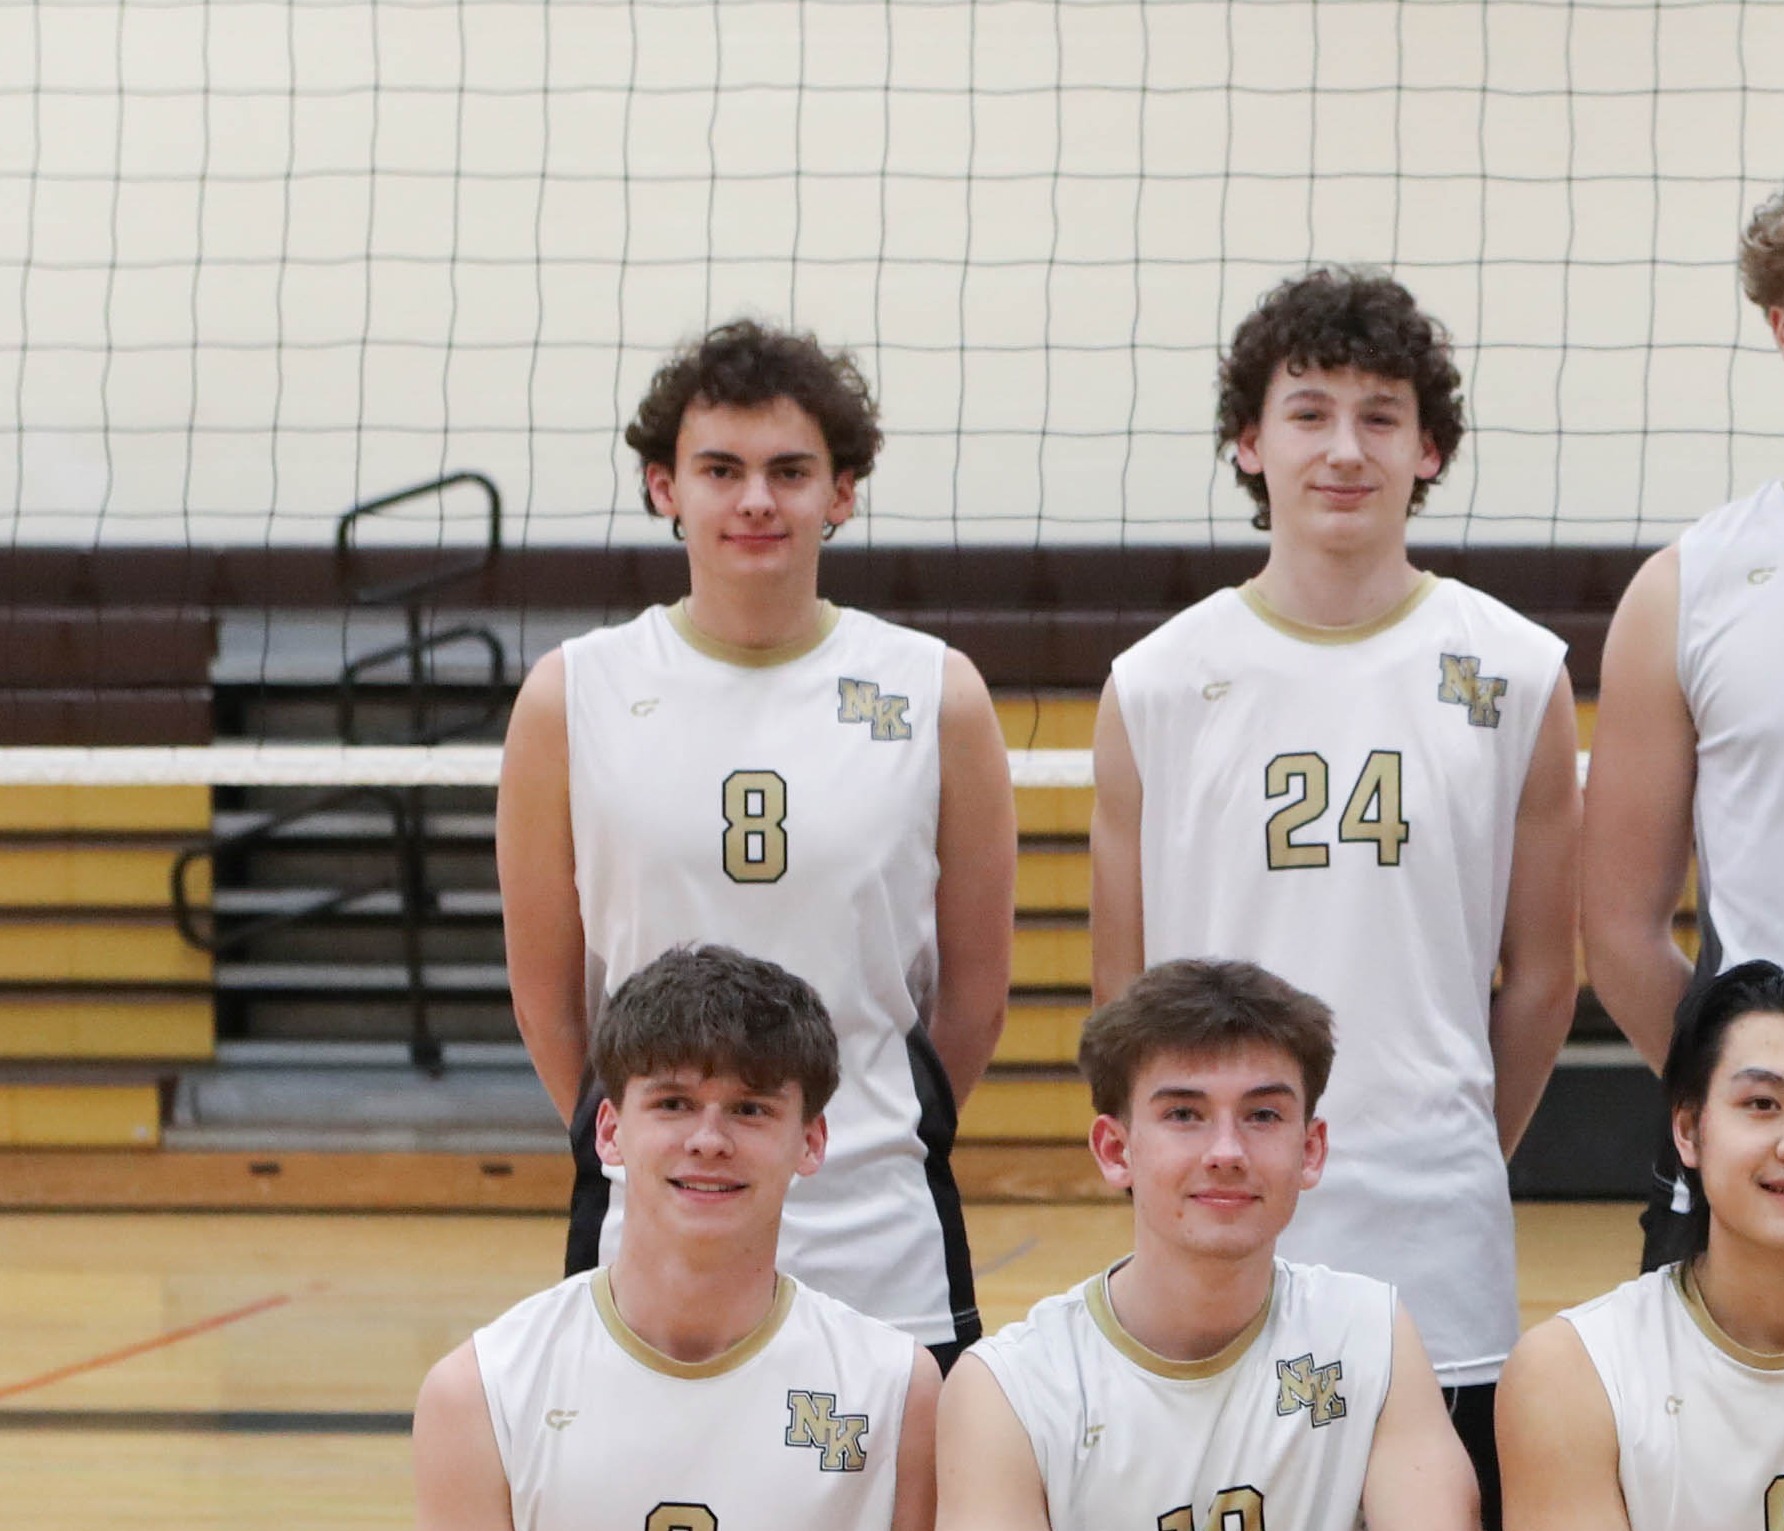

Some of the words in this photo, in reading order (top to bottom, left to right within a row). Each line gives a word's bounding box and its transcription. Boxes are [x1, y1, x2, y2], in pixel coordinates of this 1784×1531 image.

[838, 677, 912, 741] NK
[1438, 653, 1507, 728] NK
[722, 769, 788, 883] 8
[1265, 750, 1409, 870] 24
[1276, 1353, 1346, 1427] NK
[785, 1390, 868, 1471] NK
